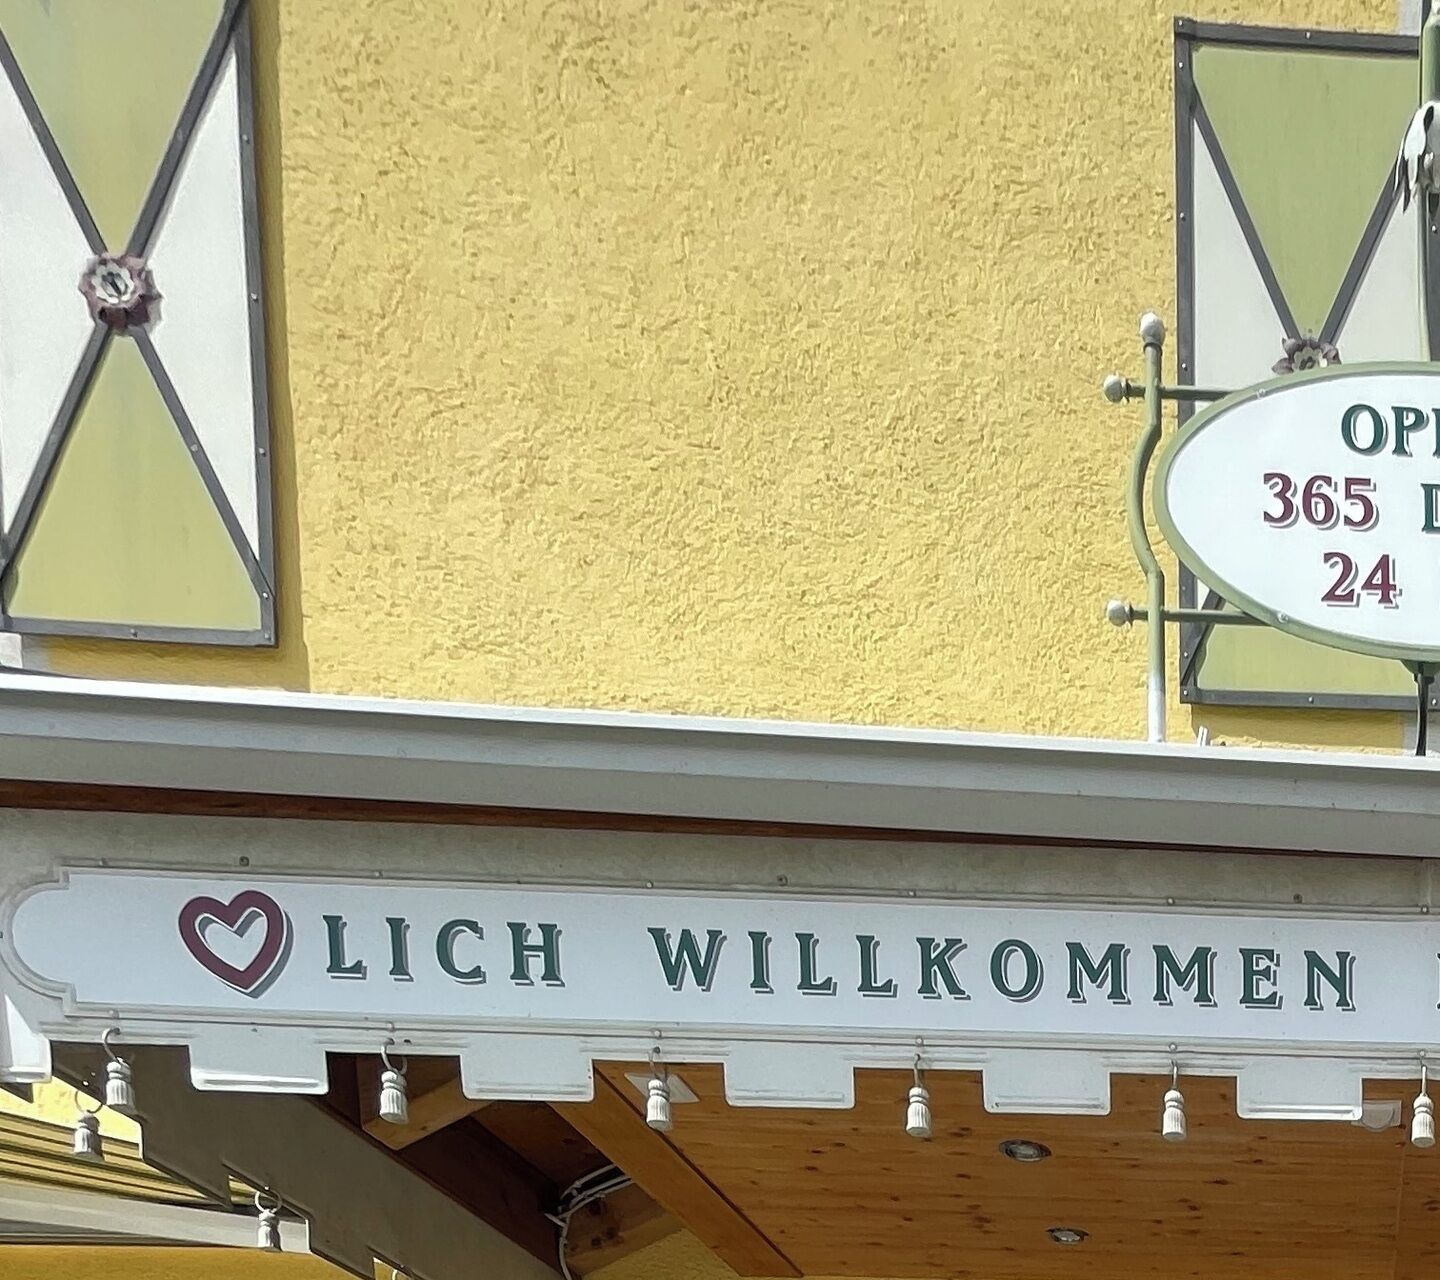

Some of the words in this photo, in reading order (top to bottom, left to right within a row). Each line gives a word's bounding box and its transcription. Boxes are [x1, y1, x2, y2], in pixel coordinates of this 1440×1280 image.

[1262, 472, 1379, 531] 365
[1321, 551, 1399, 608] 24
[322, 914, 565, 988] LICH
[648, 926, 1357, 1012] WILLKOMMEN
